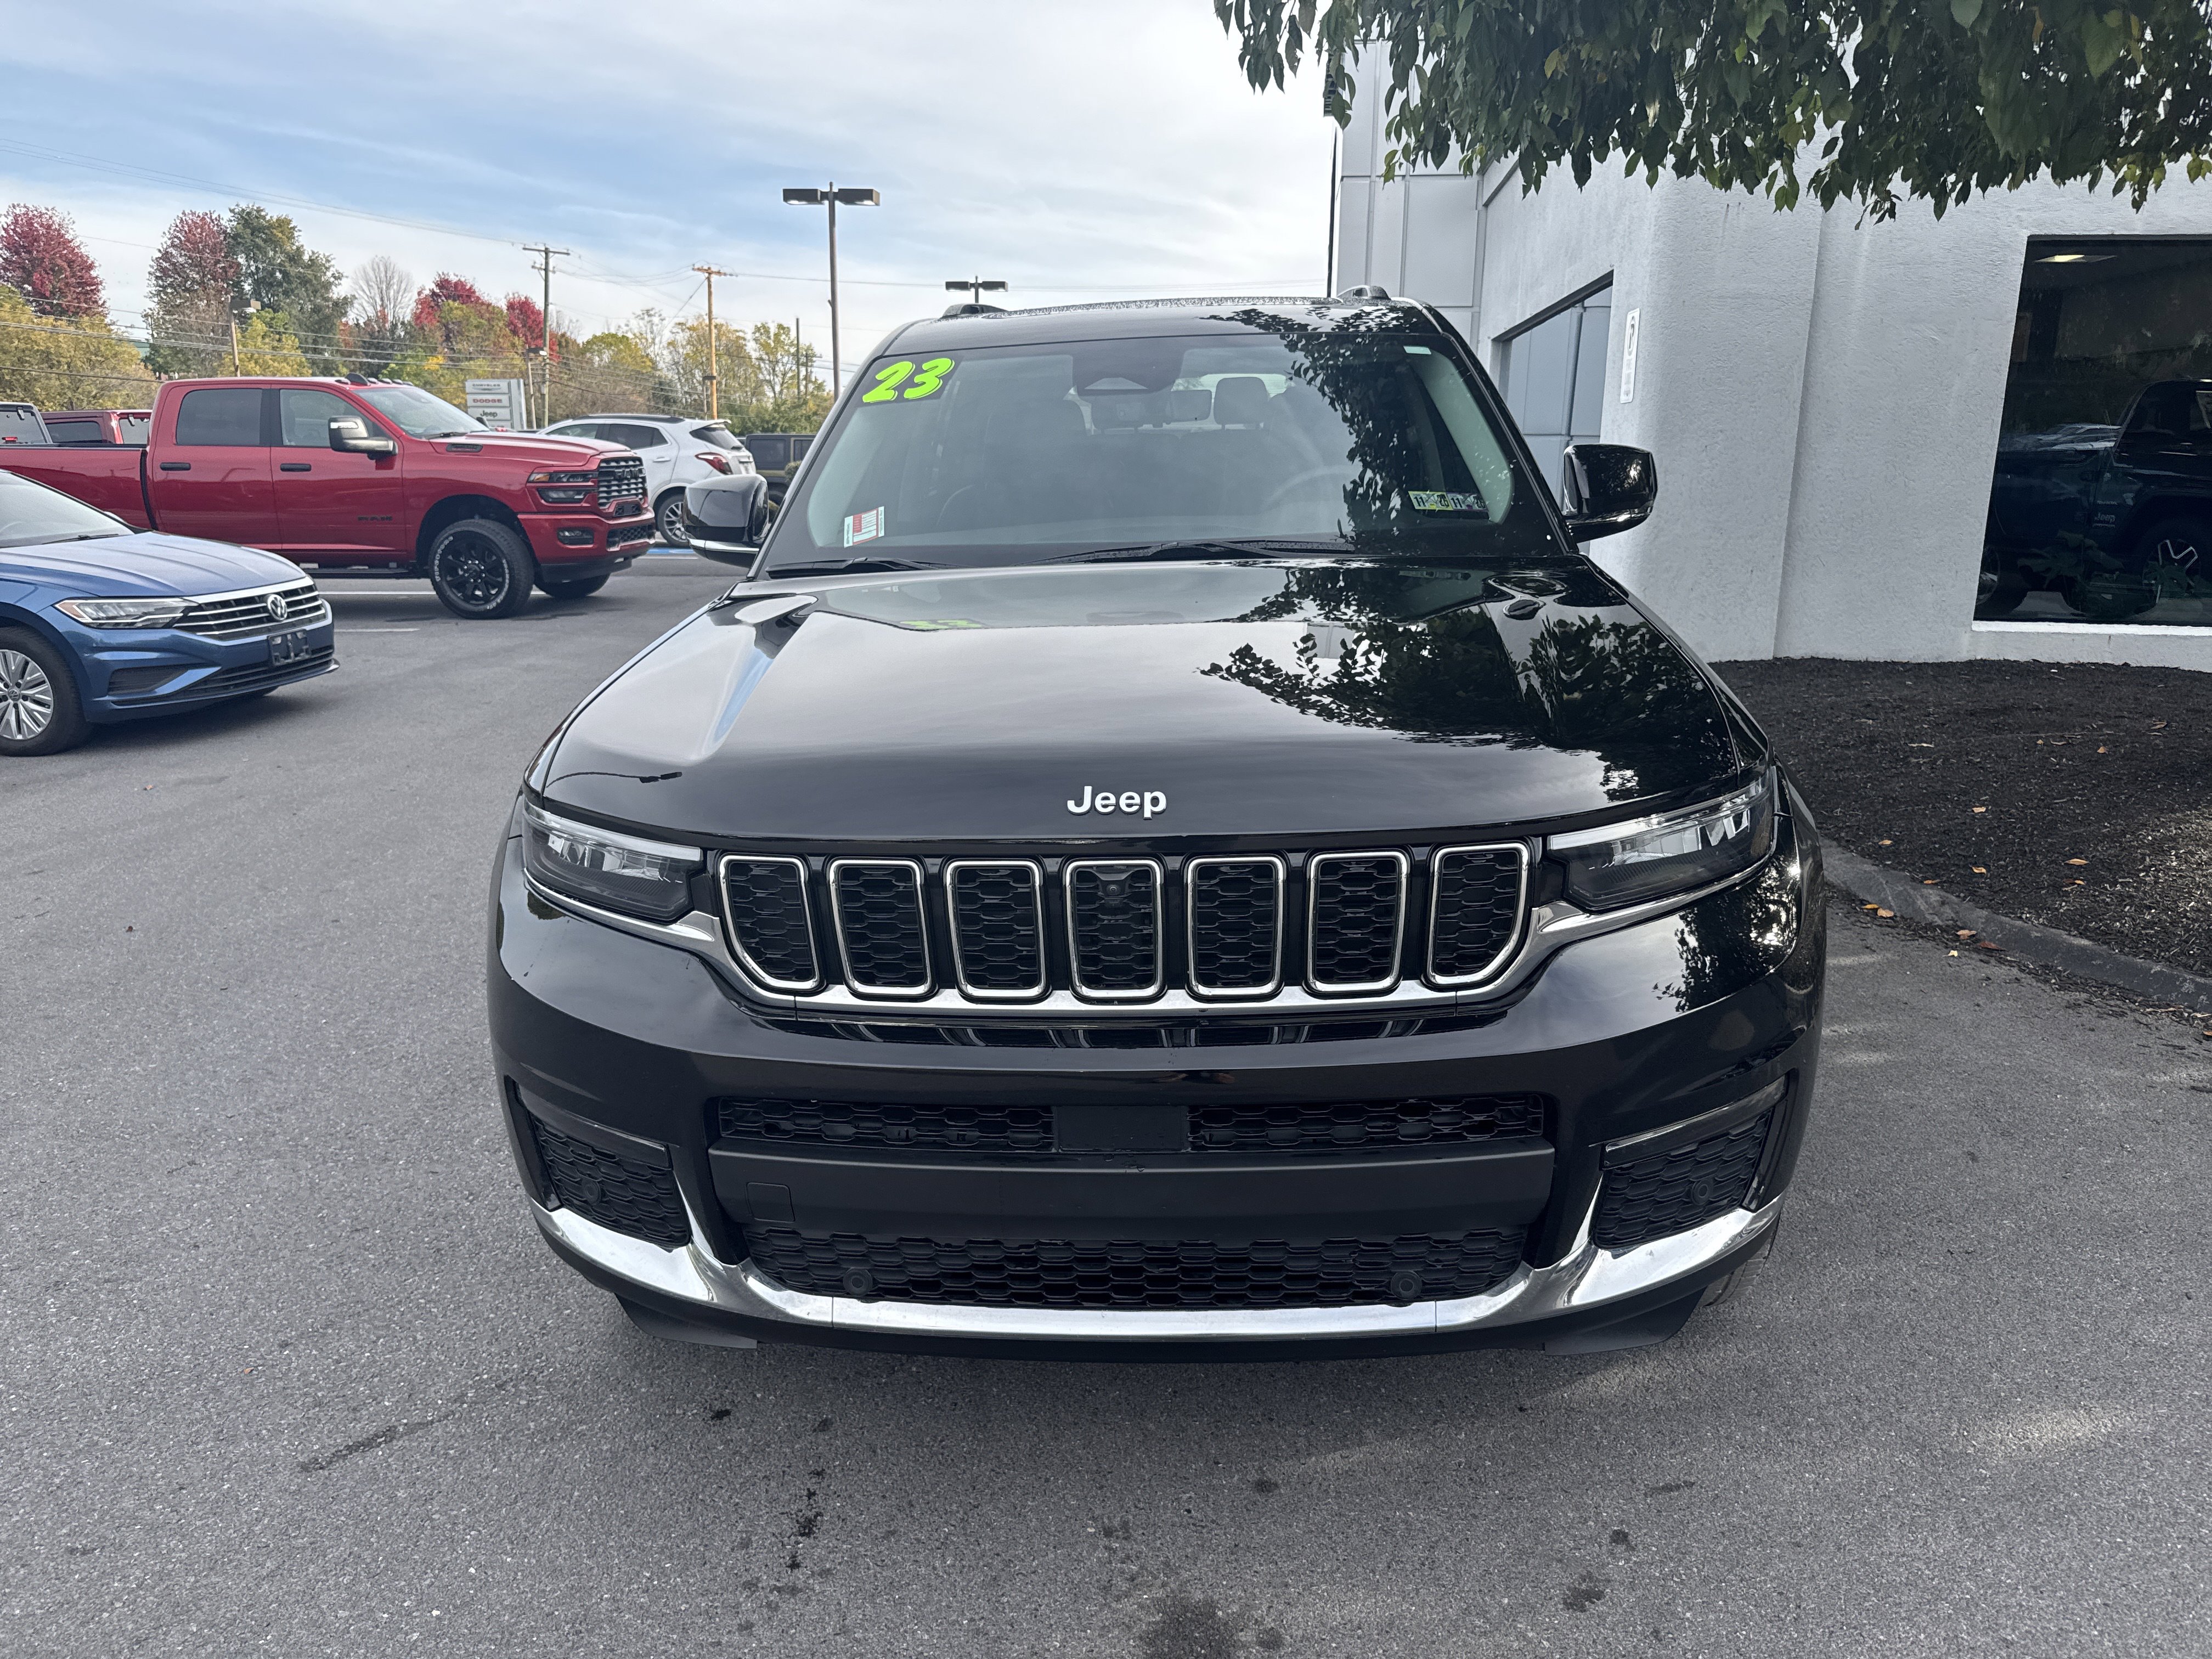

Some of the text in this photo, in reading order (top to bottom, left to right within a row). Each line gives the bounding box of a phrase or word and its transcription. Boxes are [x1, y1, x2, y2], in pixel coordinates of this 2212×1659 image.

[862, 358, 955, 403] 23
[1414, 496, 1426, 507] 11
[1451, 497, 1463, 508] 11
[1066, 786, 1167, 820] Jeep
